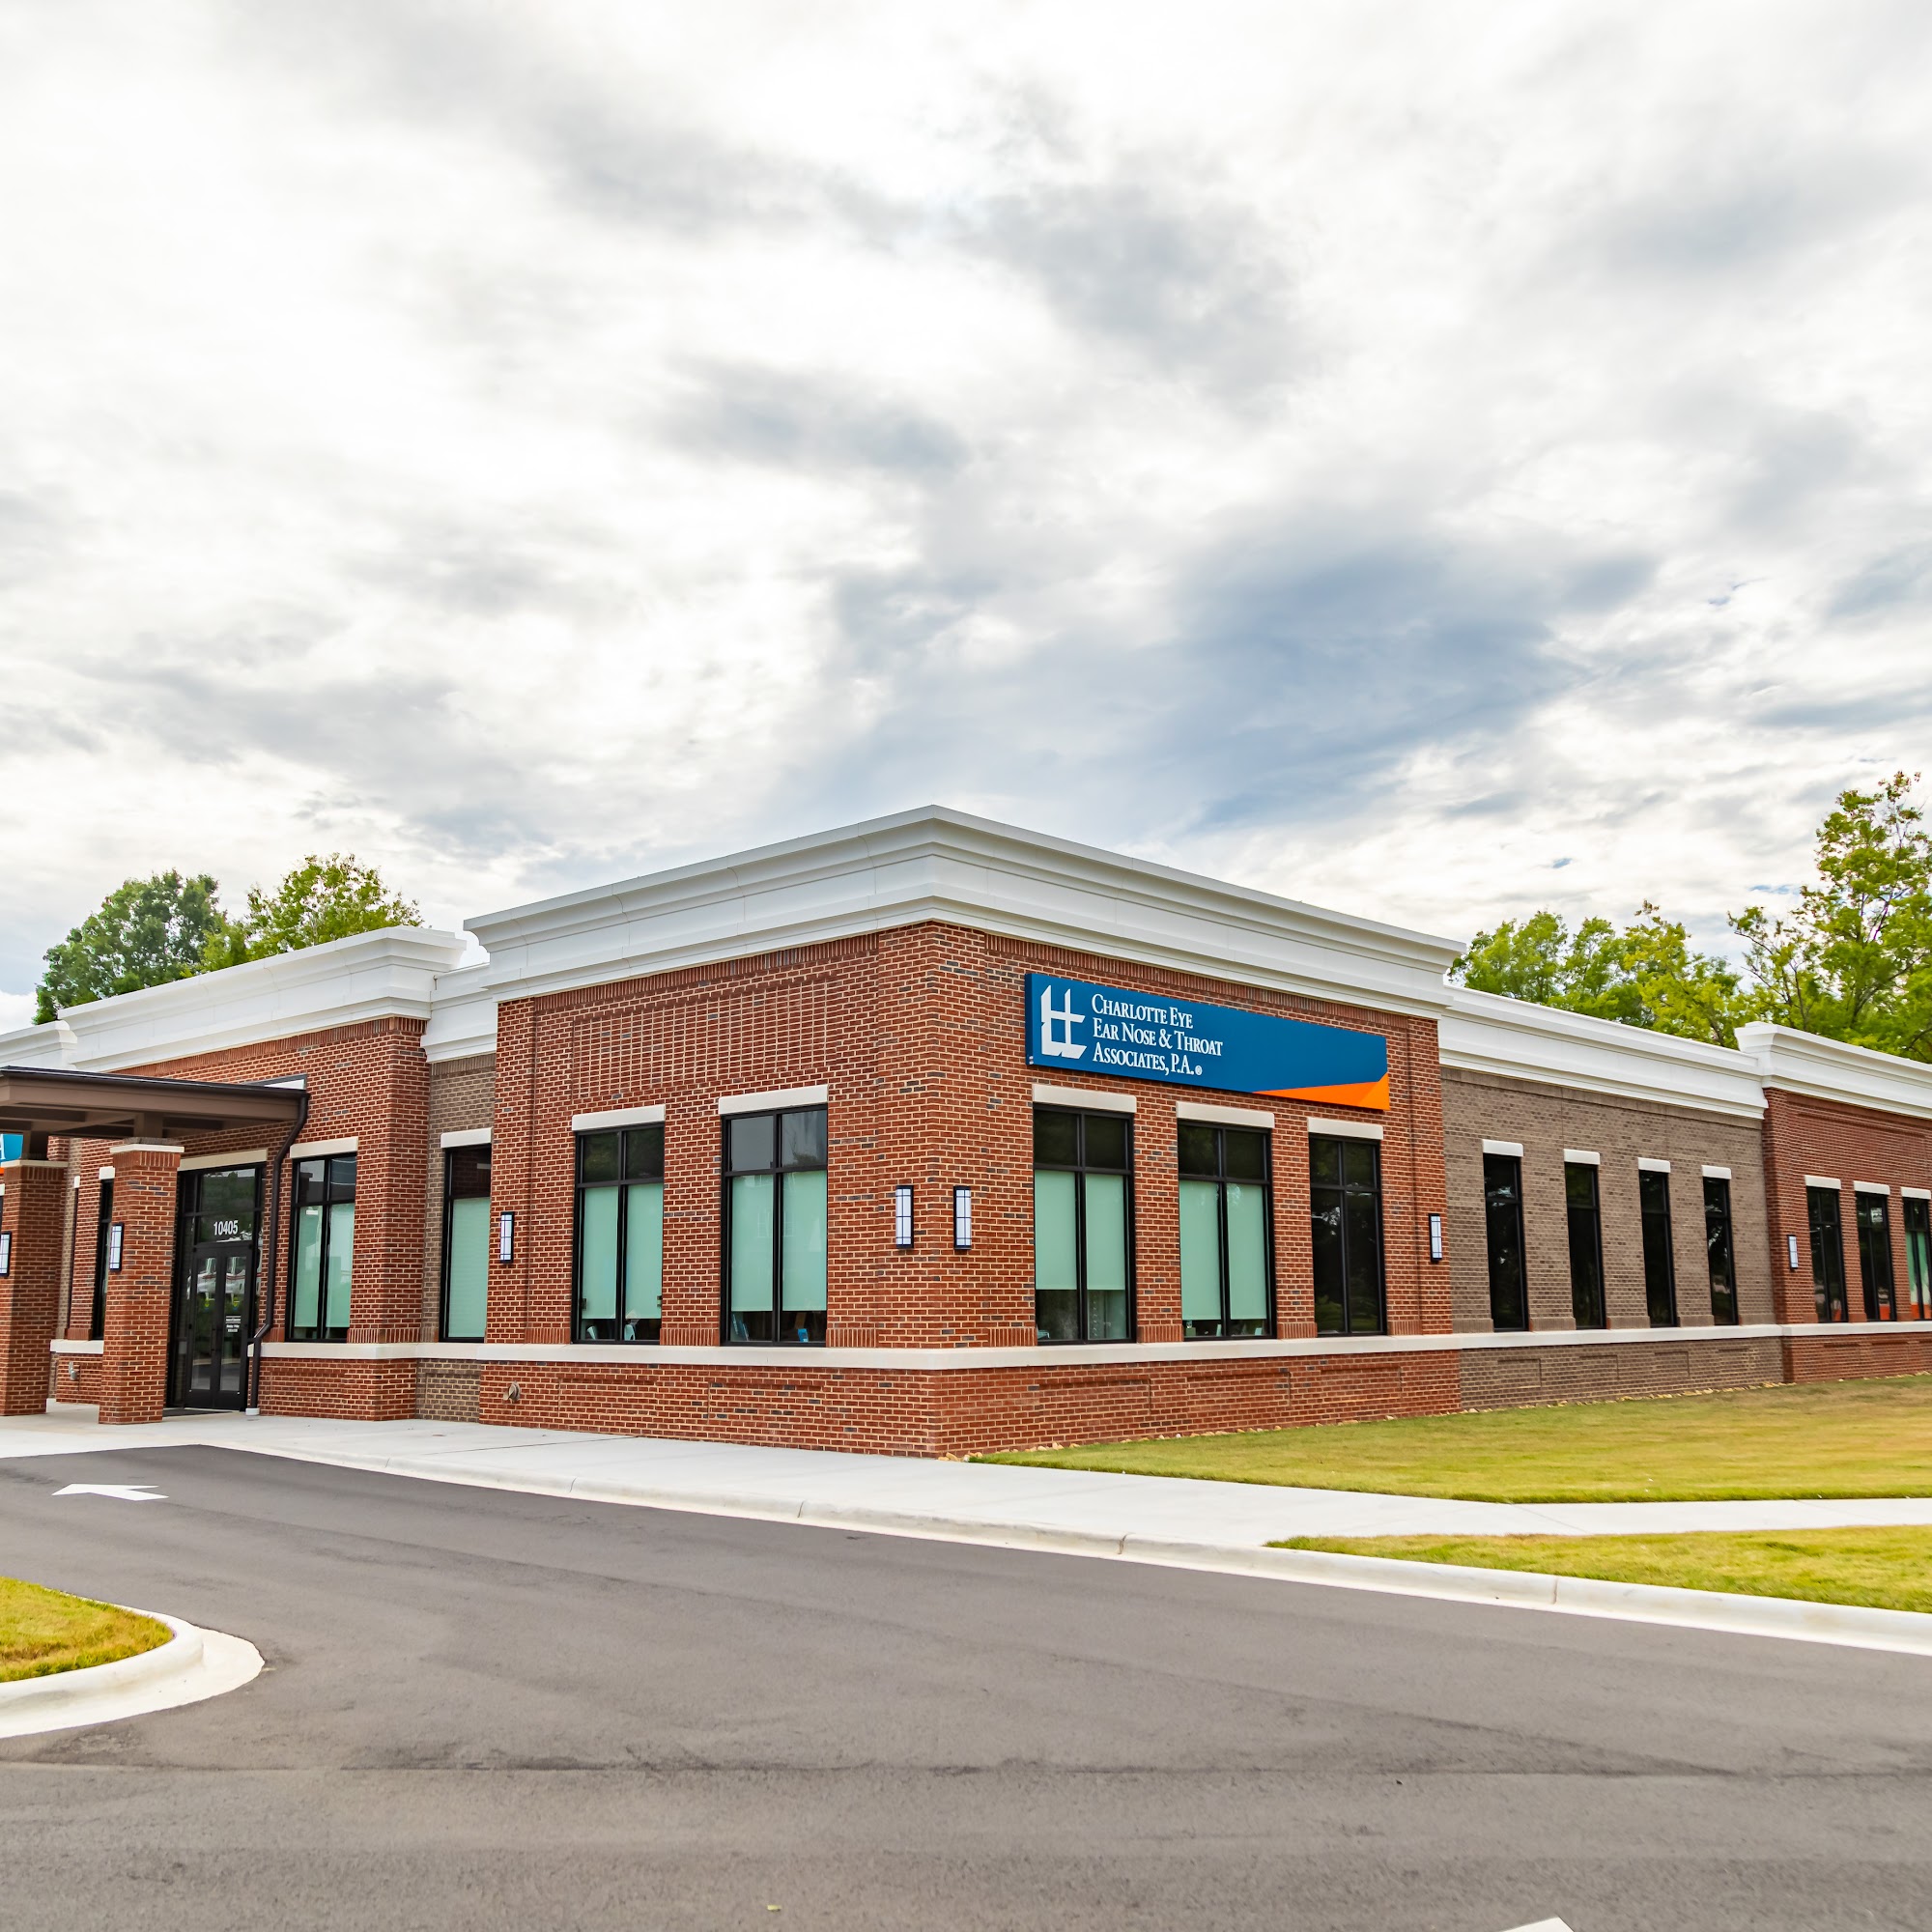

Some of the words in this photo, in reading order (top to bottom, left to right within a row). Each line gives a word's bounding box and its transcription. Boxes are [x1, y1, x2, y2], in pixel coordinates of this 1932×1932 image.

[1092, 993, 1168, 1024] CHARLOTTE
[1169, 1007, 1193, 1029] EYE
[1093, 1017, 1120, 1041] EAR
[1122, 1022, 1156, 1046] NOSE
[1158, 1028, 1173, 1049] &
[1174, 1030, 1223, 1056] THROAT
[213, 1220, 239, 1236] 10405
